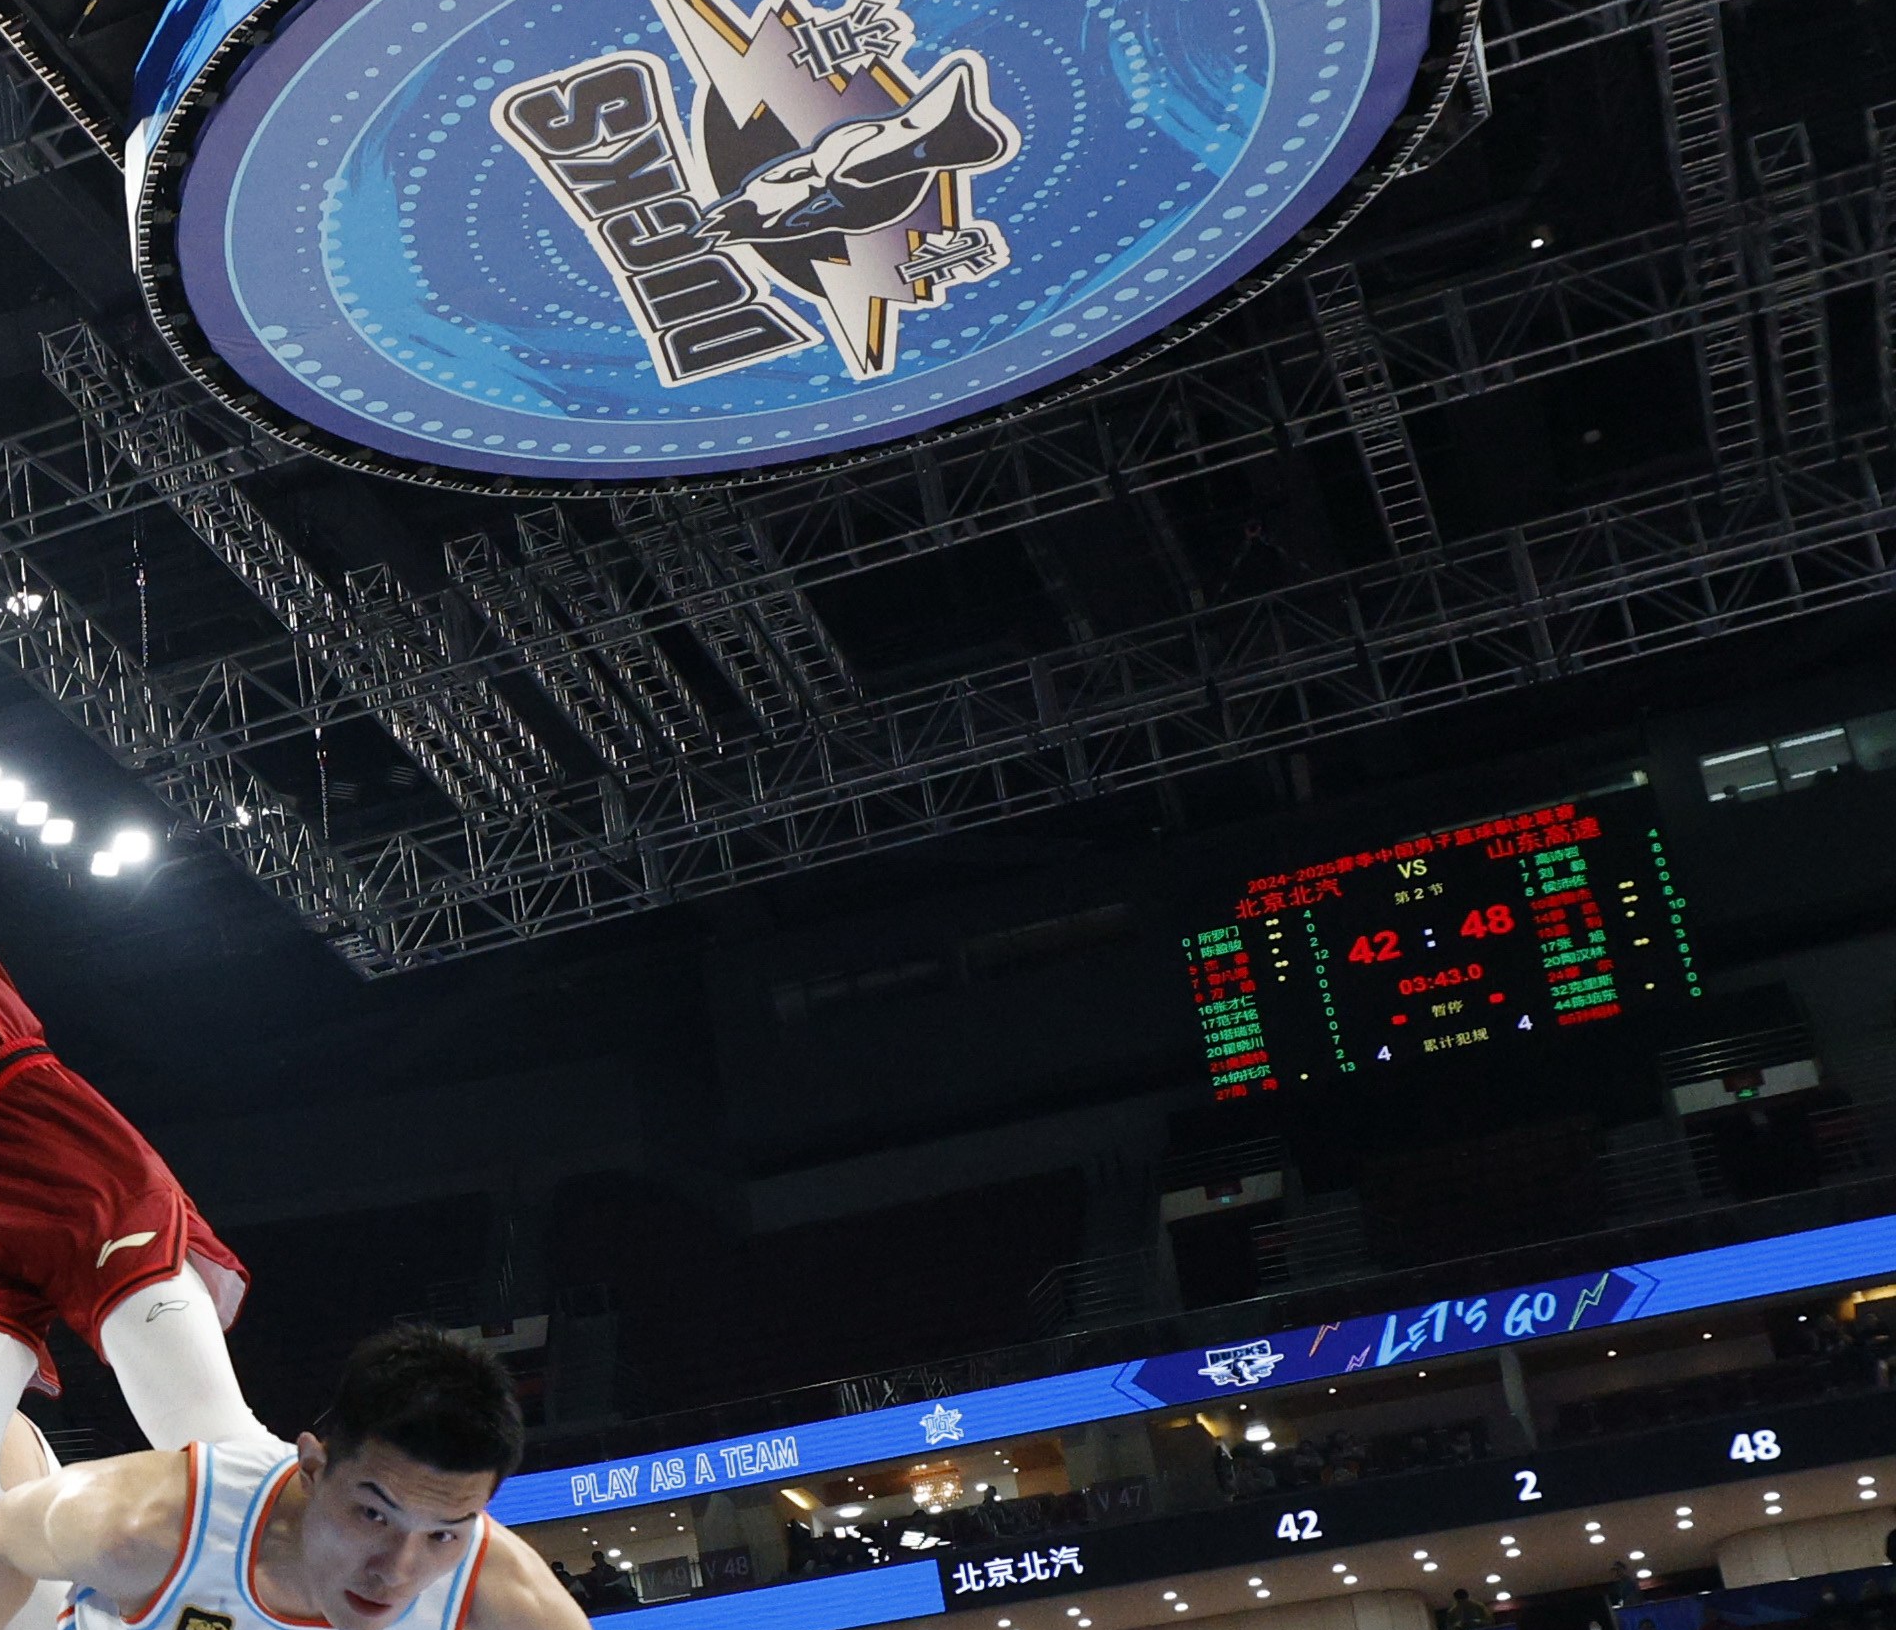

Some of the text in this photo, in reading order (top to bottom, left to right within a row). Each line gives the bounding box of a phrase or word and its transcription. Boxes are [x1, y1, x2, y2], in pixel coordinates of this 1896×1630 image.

[515, 58, 812, 382] DUCKS
[1486, 816, 1602, 859] 山东高速
[1519, 859, 1526, 868] 1
[1655, 857, 1666, 868] 0
[1397, 859, 1428, 879] VS
[1522, 873, 1529, 882] 7
[1659, 871, 1669, 882] 0
[1234, 878, 1344, 920] 北京北汽
[1460, 903, 1515, 939] 48
[1671, 914, 1681, 925] 0
[1182, 938, 1190, 948] 0
[1302, 909, 1312, 919] 4
[1186, 951, 1192, 961] 1
[1306, 923, 1316, 933] 0
[1309, 937, 1318, 947] 2
[1347, 930, 1404, 964] 42
[1314, 949, 1330, 959] 12
[1316, 964, 1325, 974] 0
[1398, 963, 1483, 996] 03:43.0
[1686, 971, 1697, 982] 0
[1319, 978, 1328, 988] 0
[1690, 986, 1701, 997] 0
[1322, 993, 1332, 1003] 2
[1325, 1006, 1335, 1016] 0
[1328, 1020, 1338, 1030] 0
[1517, 1014, 1533, 1031] 4
[1332, 1035, 1341, 1045] 7
[1336, 1049, 1345, 1059] 2
[1376, 1044, 1392, 1062] 4
[1340, 1062, 1356, 1072] 13
[570, 1436, 799, 1506] PLAY AS A TEAM
[952, 1428, 1781, 1595] 北京北汽 42 2 48
